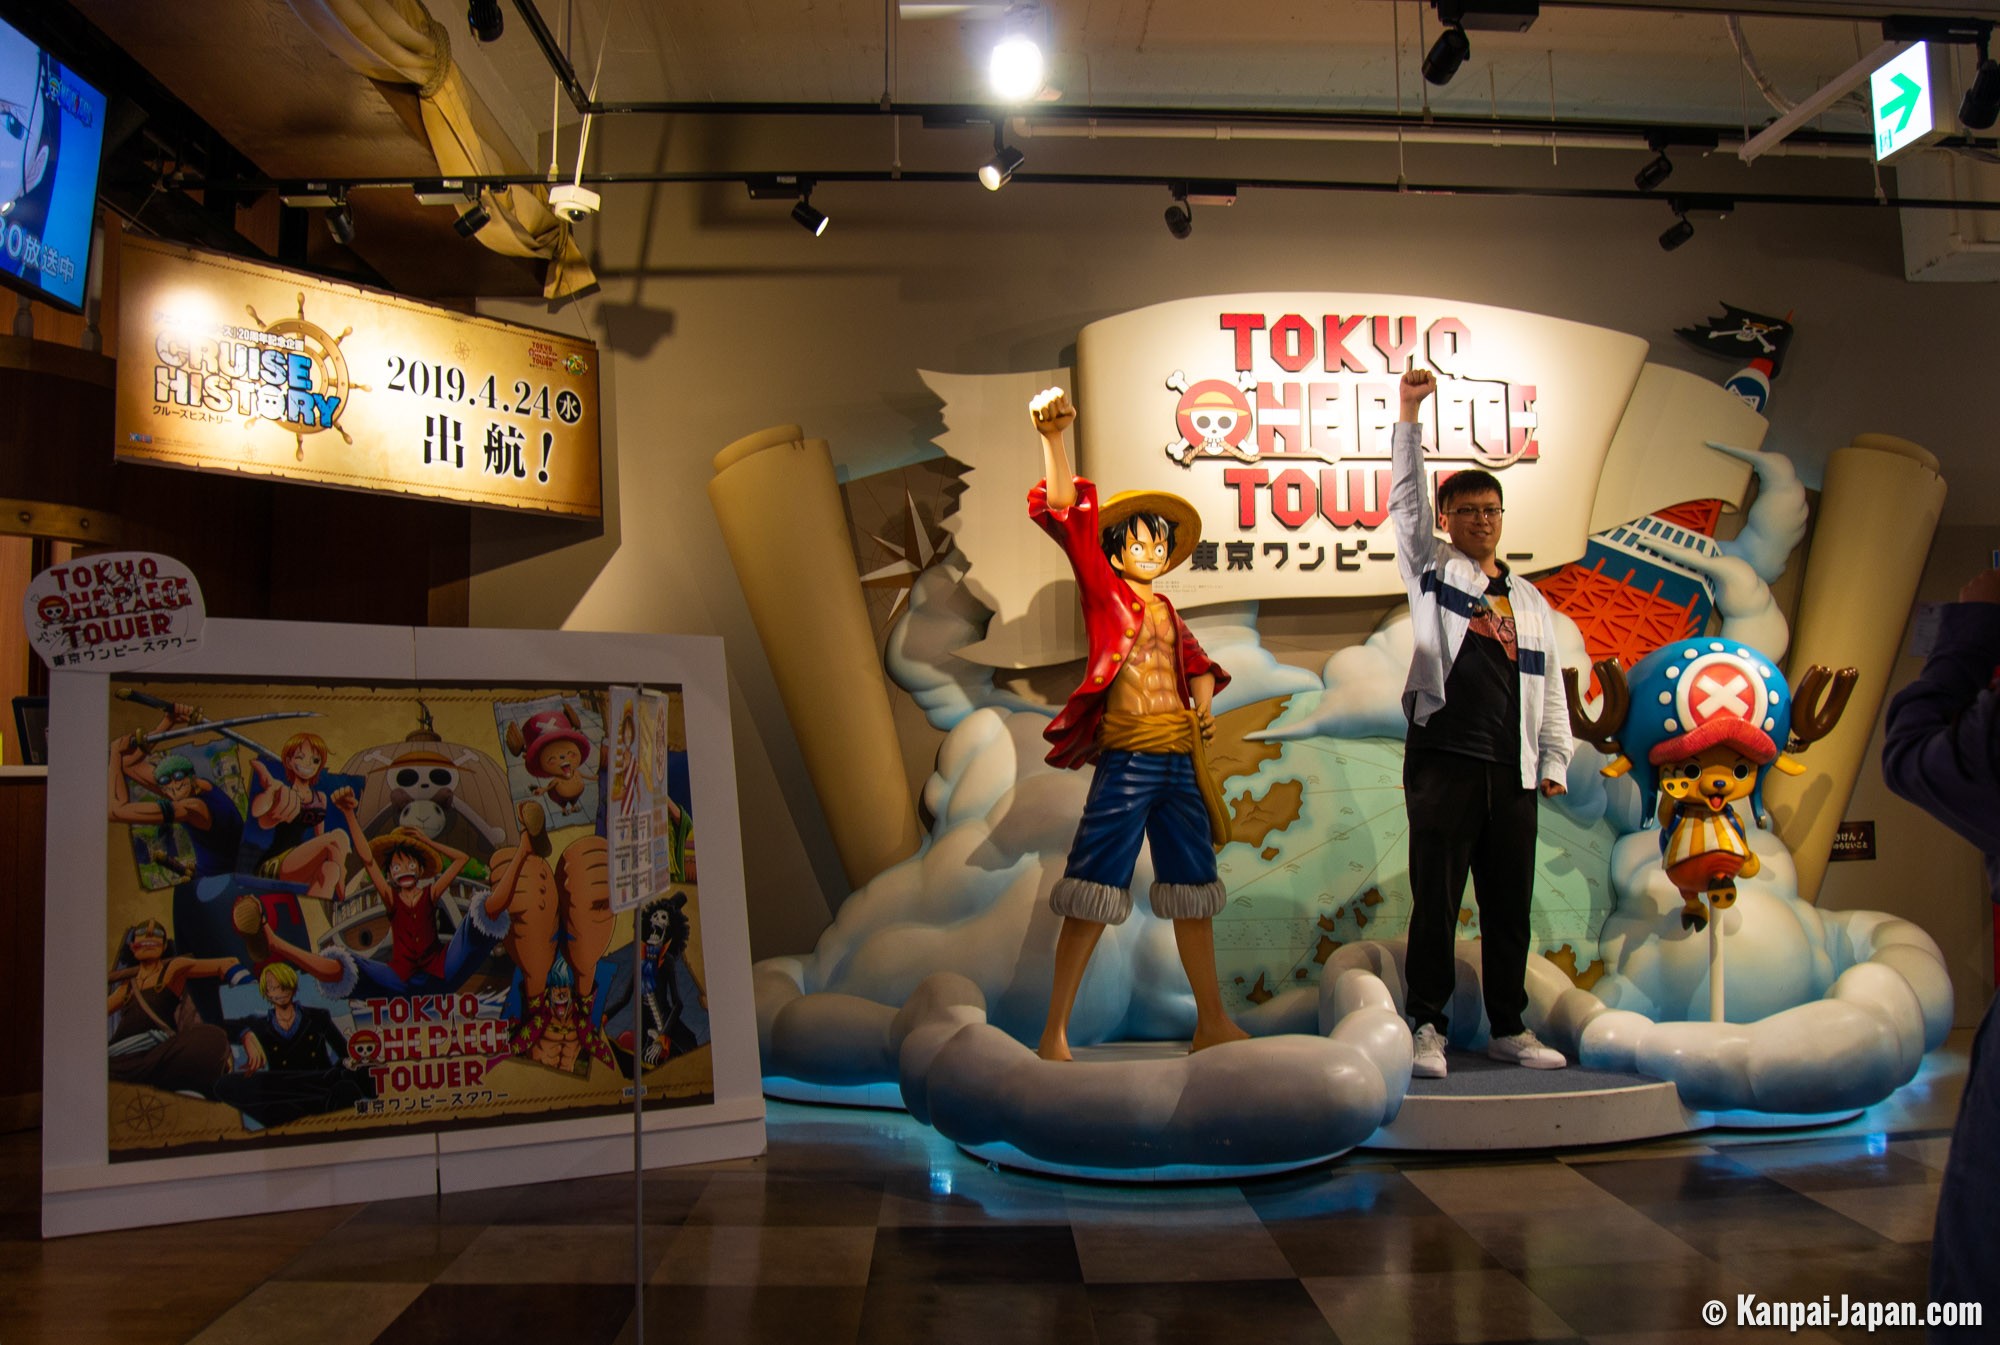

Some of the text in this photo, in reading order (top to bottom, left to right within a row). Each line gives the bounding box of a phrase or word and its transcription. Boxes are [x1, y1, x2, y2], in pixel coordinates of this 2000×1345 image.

[155, 330, 314, 390] CRUISE
[1220, 314, 1472, 376] TOKYO
[153, 365, 341, 428] HISTORY
[152, 405, 233, 424] クルーズヒストリー
[1224, 468, 1463, 530] TOW
[1190, 540, 1534, 571] 東京ワンピーー
[51, 558, 158, 591] TOKYO
[63, 614, 171, 648] TOWER
[52, 637, 198, 667] 東京ワンピースタワー
[366, 993, 479, 1026] TOKYO
[428, 1014, 511, 1058] PIECE
[369, 1060, 484, 1094] TOWER
[355, 1090, 509, 1114] 東京ワンピースタワー
